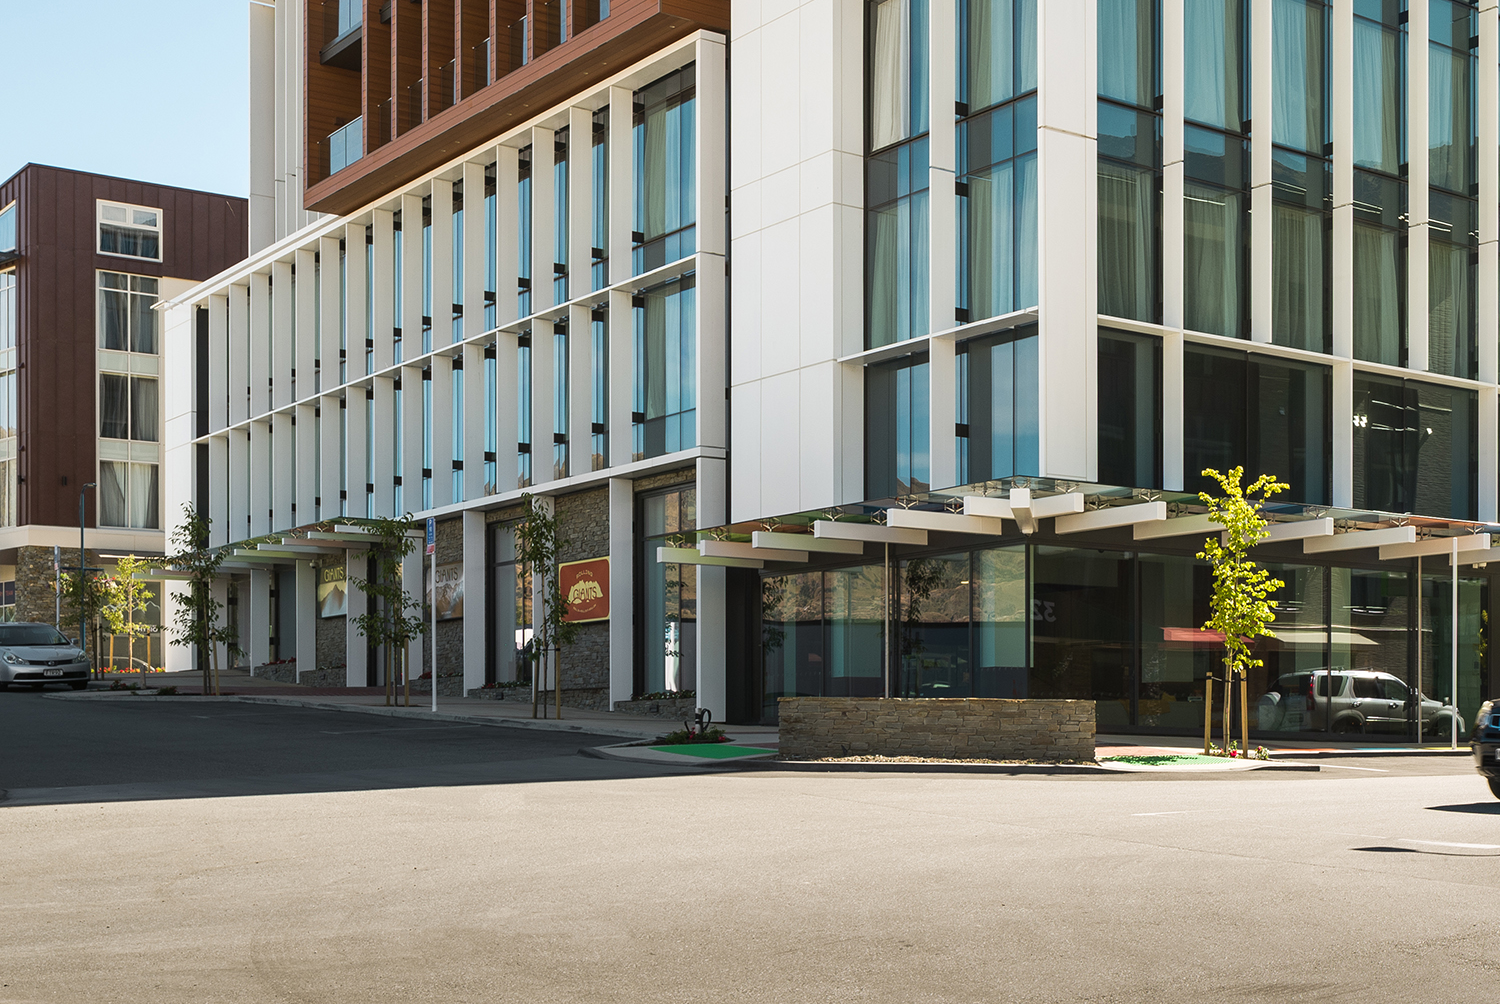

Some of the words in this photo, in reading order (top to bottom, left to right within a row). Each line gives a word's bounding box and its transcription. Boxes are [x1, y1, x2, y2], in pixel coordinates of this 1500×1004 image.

[323, 566, 344, 582] GIANTS
[435, 567, 459, 584] GIANTS
[572, 586, 598, 600] GIANTS
